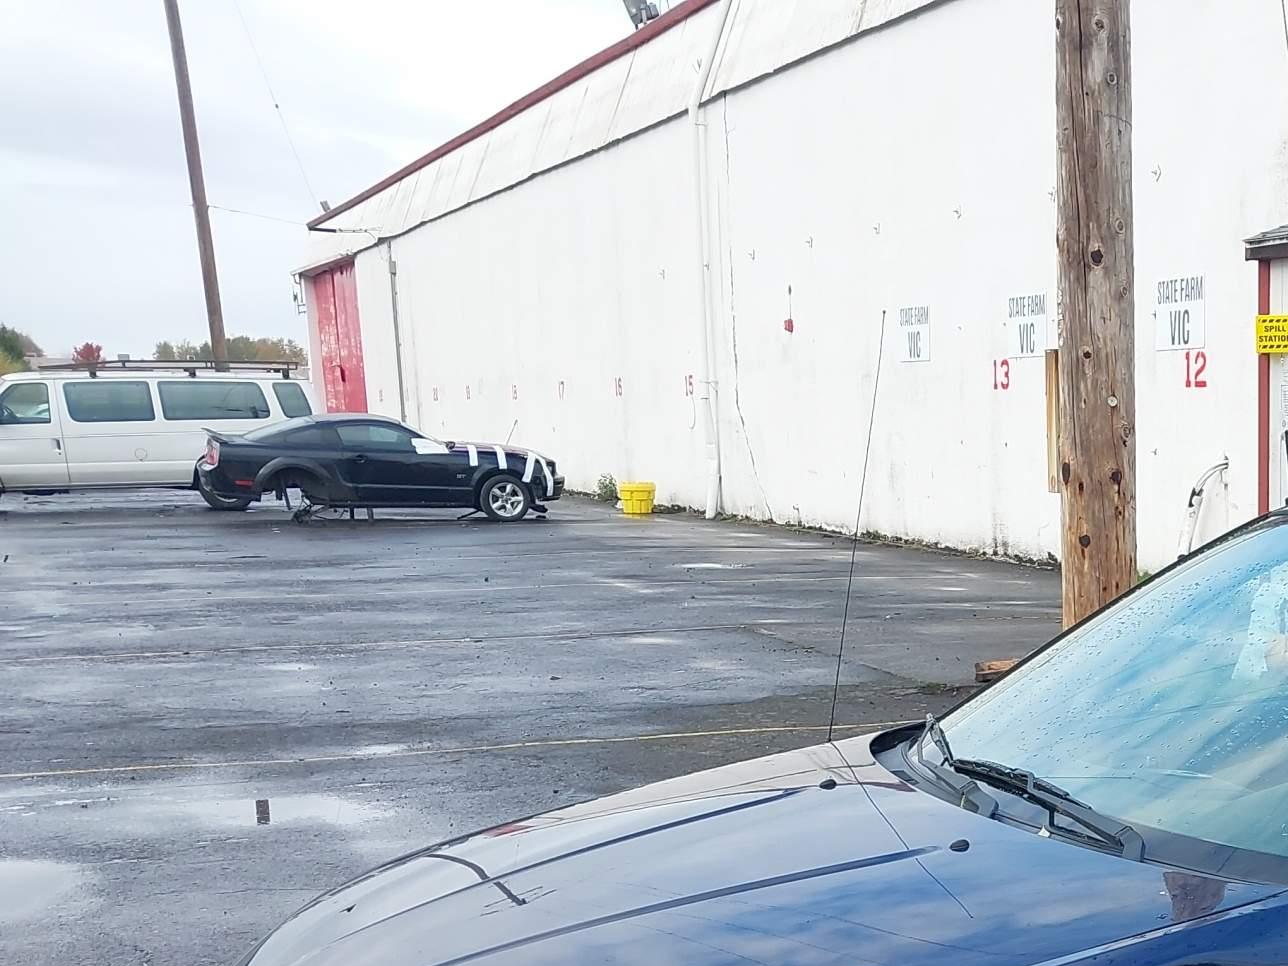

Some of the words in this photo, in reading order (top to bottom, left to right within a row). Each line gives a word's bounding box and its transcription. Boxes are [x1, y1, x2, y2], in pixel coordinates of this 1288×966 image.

[1157, 279, 1178, 304] STATE
[1180, 275, 1203, 302] FARM
[899, 307, 913, 327] STATE
[914, 305, 929, 325] FARM
[1008, 296, 1026, 318] STATE
[1027, 293, 1046, 317] FARM
[1018, 322, 1035, 354] VIC
[1169, 309, 1190, 346] VIC
[1263, 325, 1287, 333] SPILL
[907, 330, 921, 359] VIC
[993, 359, 1010, 390] 13
[1185, 351, 1207, 388] 12
[684, 374, 694, 397] 15
